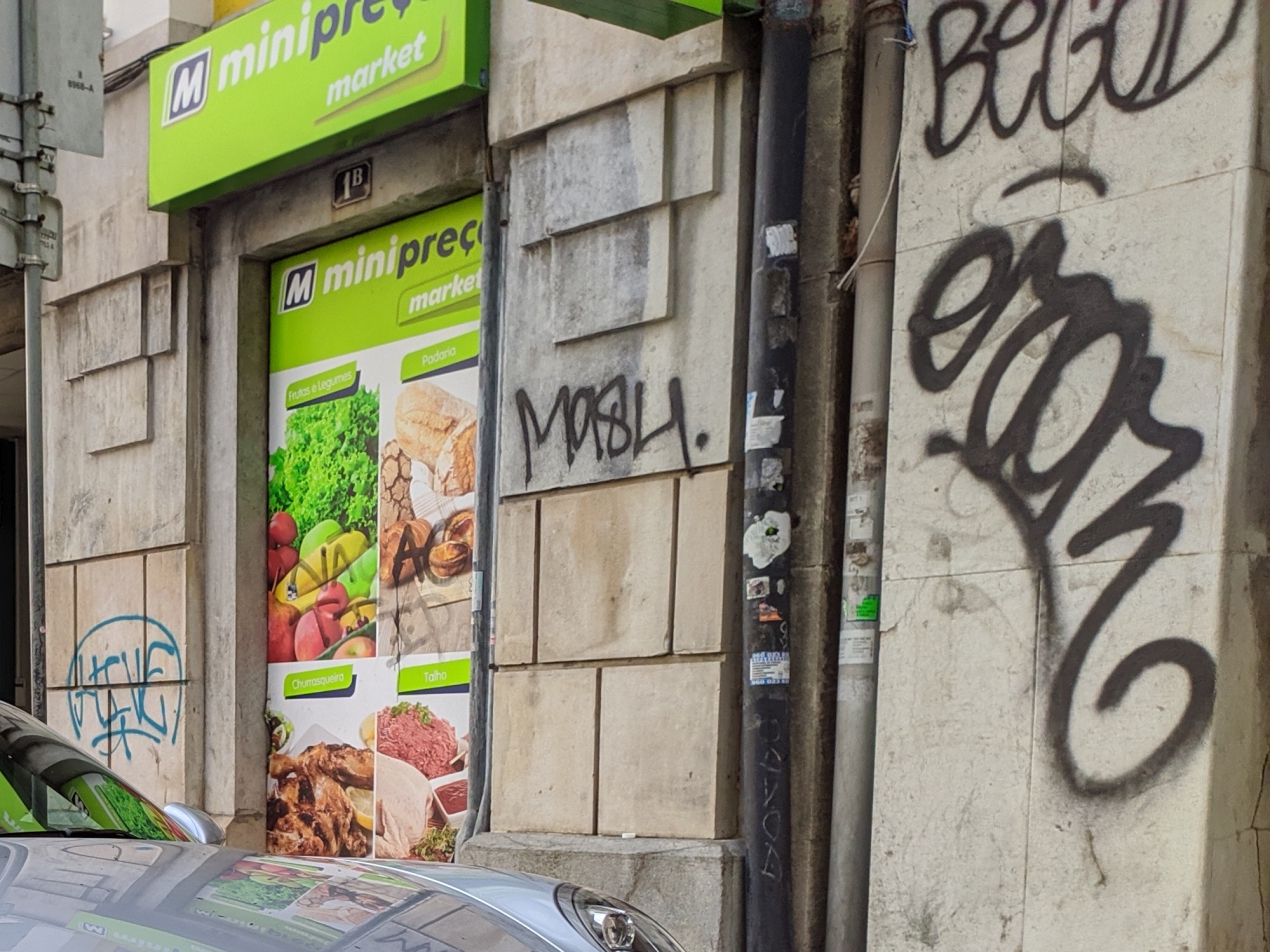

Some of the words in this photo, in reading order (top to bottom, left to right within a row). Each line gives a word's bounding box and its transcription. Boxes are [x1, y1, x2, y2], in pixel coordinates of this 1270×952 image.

[326, 31, 427, 106] market
[341, 172, 363, 200] 1B
[422, 346, 457, 367] Padaria
[288, 386, 311, 402] Frutas
[317, 371, 353, 392] Legumes
[291, 671, 345, 690] Churrasqueira
[423, 672, 448, 683] Talho
